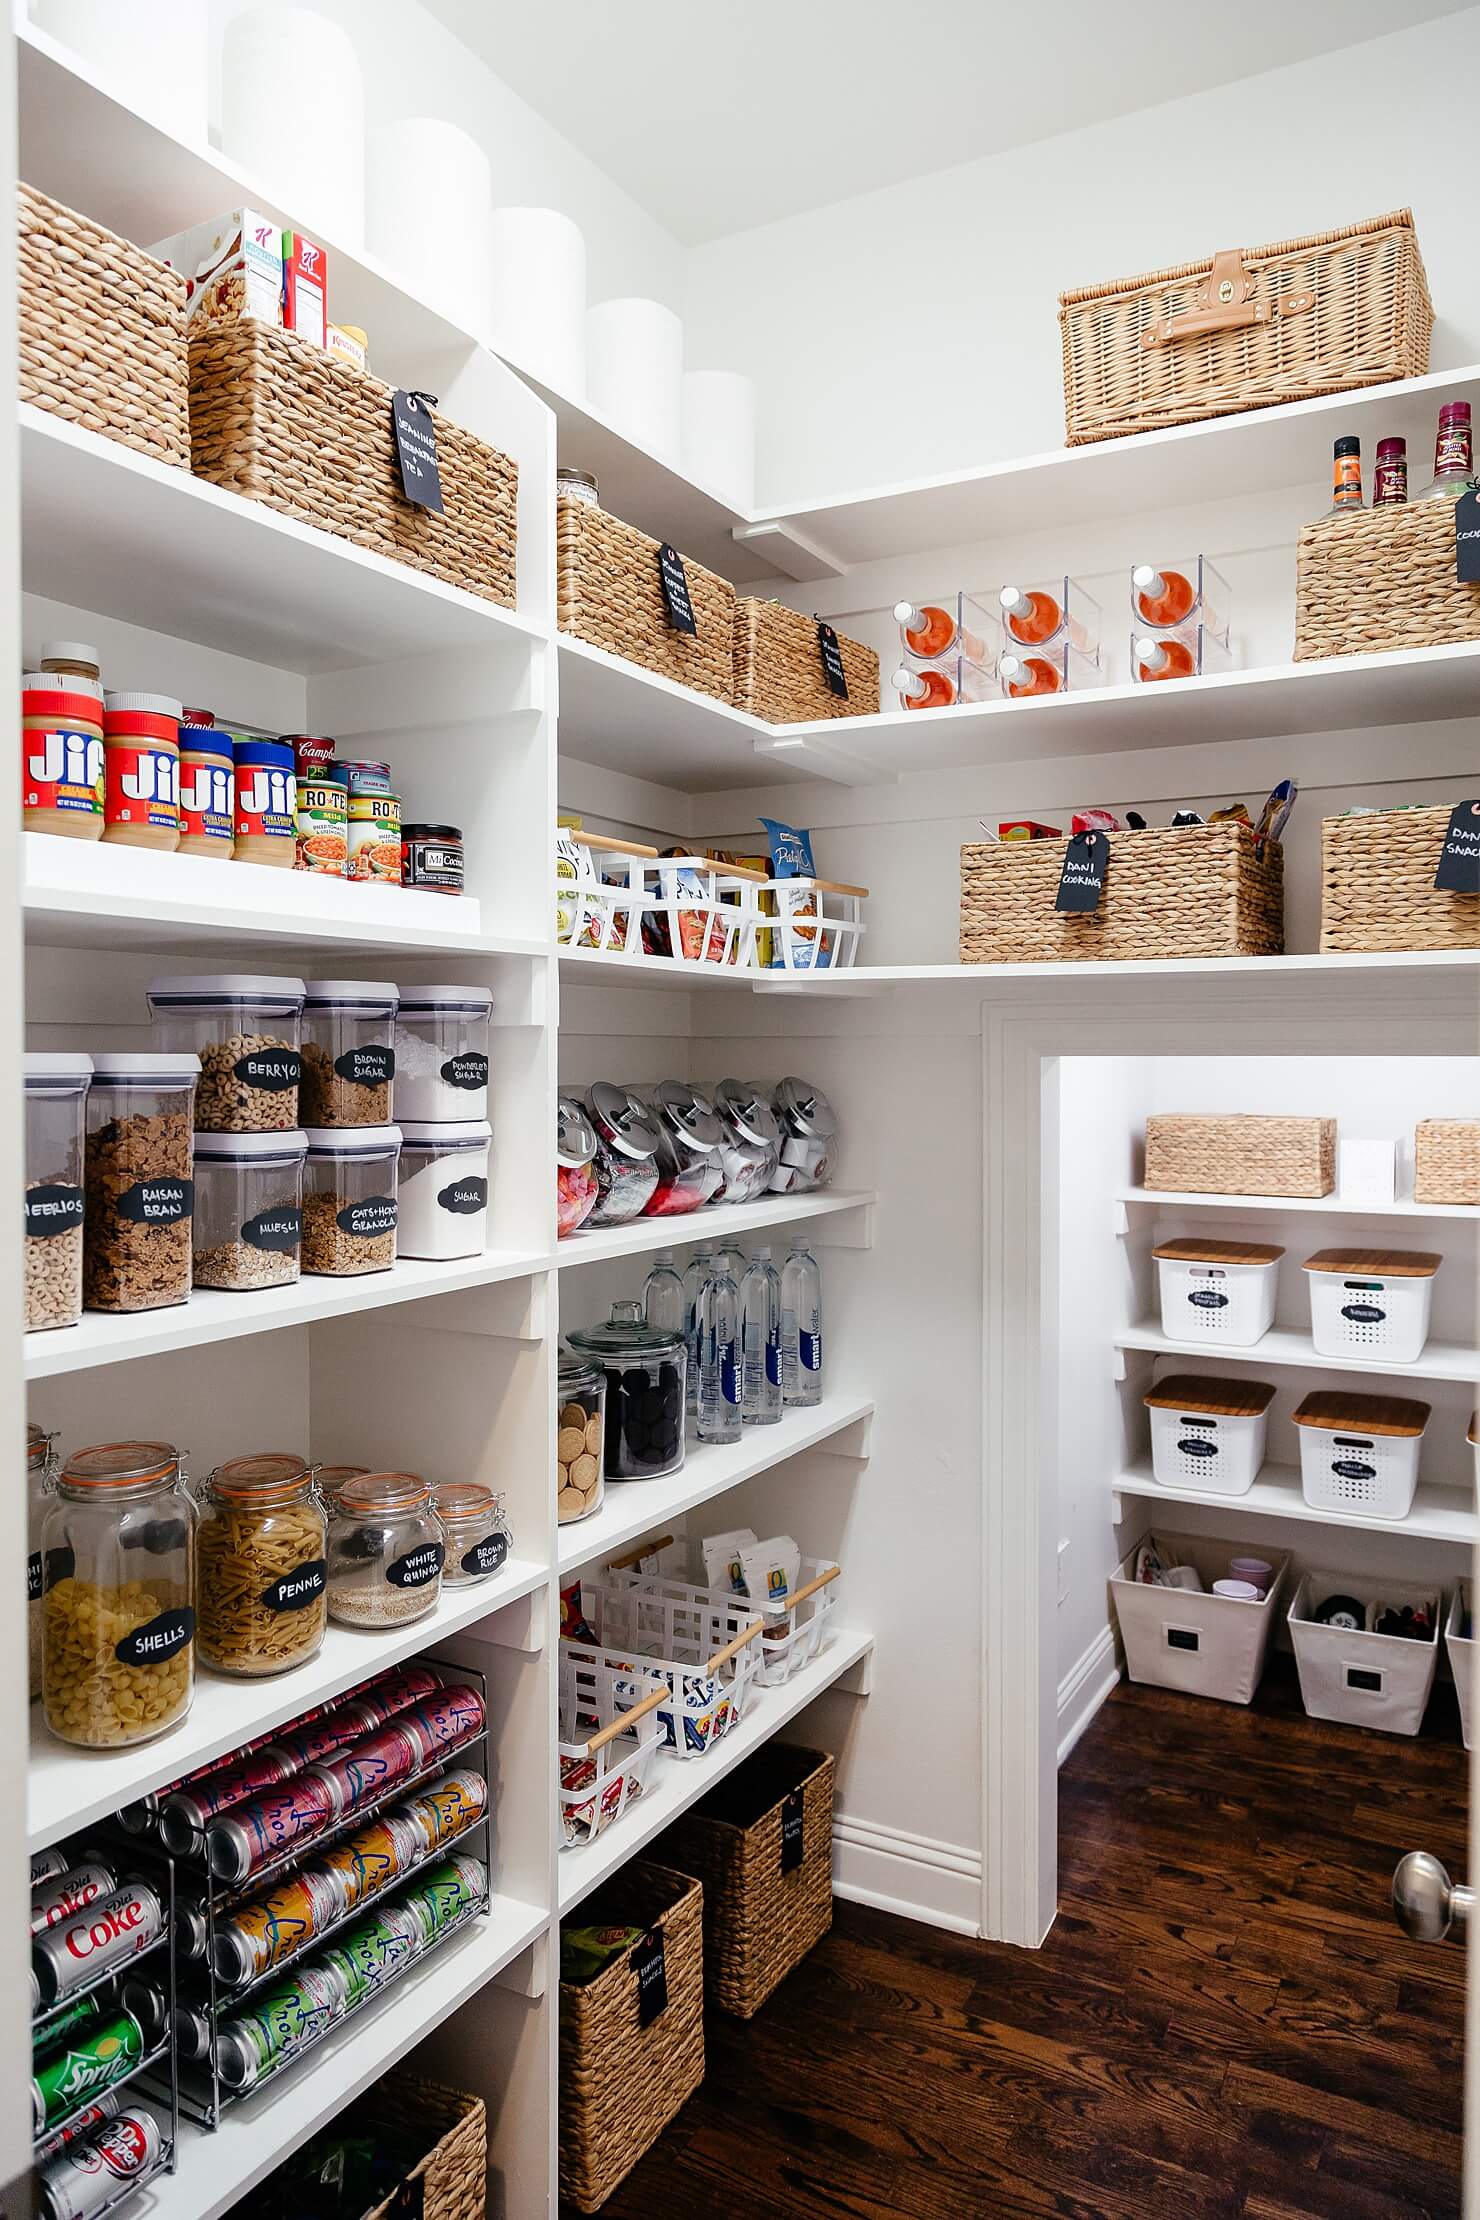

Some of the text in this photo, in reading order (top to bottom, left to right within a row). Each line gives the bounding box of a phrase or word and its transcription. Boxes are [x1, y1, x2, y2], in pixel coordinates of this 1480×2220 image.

[29, 734, 105, 783] Jif
[387, 822, 400, 831] Mil
[1452, 827, 1480, 841] DAN
[1446, 842, 1480, 857] SNAC
[429, 855, 442, 864] Mi
[1067, 861, 1094, 873] DANI
[1062, 874, 1101, 889] COOKING
[354, 1055, 386, 1066] BROWN
[353, 1067, 386, 1079] SUGAR
[454, 1071, 483, 1081] SUGAR
[142, 1188, 184, 1202] RAISAN
[453, 1191, 481, 1203] SUGAR
[25, 1199, 83, 1217] EERIOS
[144, 1203, 182, 1217] BRAN
[259, 1222, 300, 1236] MUESLI
[351, 1217, 396, 1231] GRANOLA
[476, 1543, 504, 1560] BROWN
[405, 1549, 438, 1570] WHITE
[480, 1553, 499, 1569] RICE
[403, 1563, 440, 1583] QUINOA
[277, 1572, 323, 1601] PENNE
[135, 1624, 186, 1654] SHELLS
[105, 1893, 134, 1912] Diet
[65, 1902, 145, 1959] Coke
[63, 2055, 128, 2095] Sprite
[115, 2124, 141, 2149] Dr
[97, 2121, 139, 2169] Pepper
